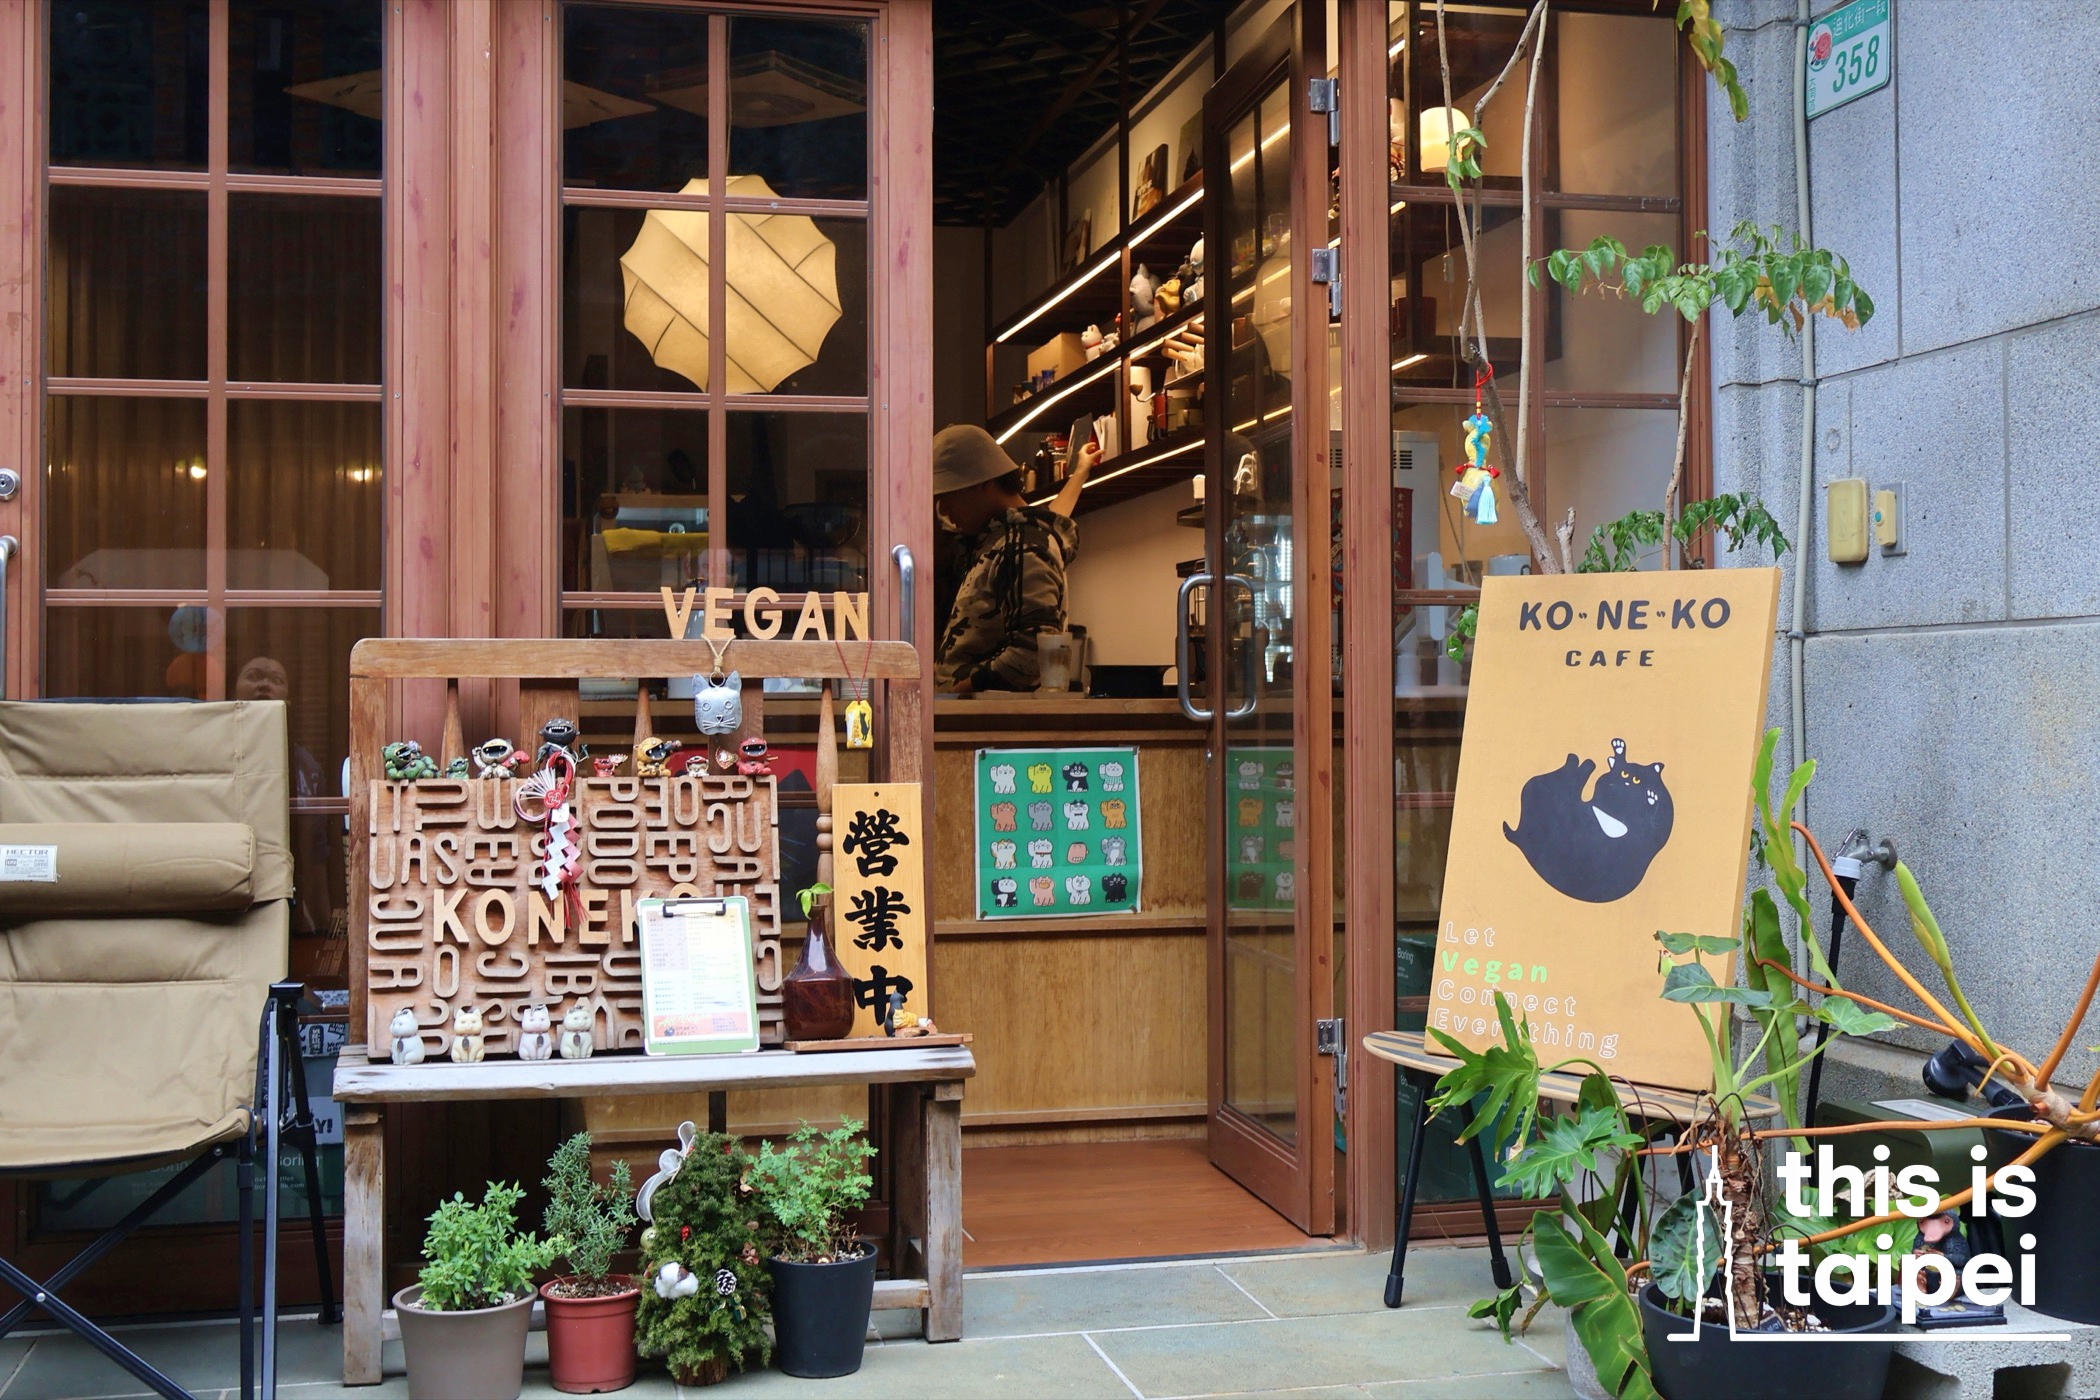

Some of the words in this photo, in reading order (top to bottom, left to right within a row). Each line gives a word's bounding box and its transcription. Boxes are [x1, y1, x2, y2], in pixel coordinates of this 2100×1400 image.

[1832, 34, 1880, 93] 358
[660, 586, 869, 641] VEGAN
[1565, 650, 1656, 667] CAFE
[842, 808, 914, 1027] 營業中
[1445, 921, 1496, 948] Let
[1441, 950, 1549, 984] Vegan
[1434, 1008, 1619, 1059] Everthing
